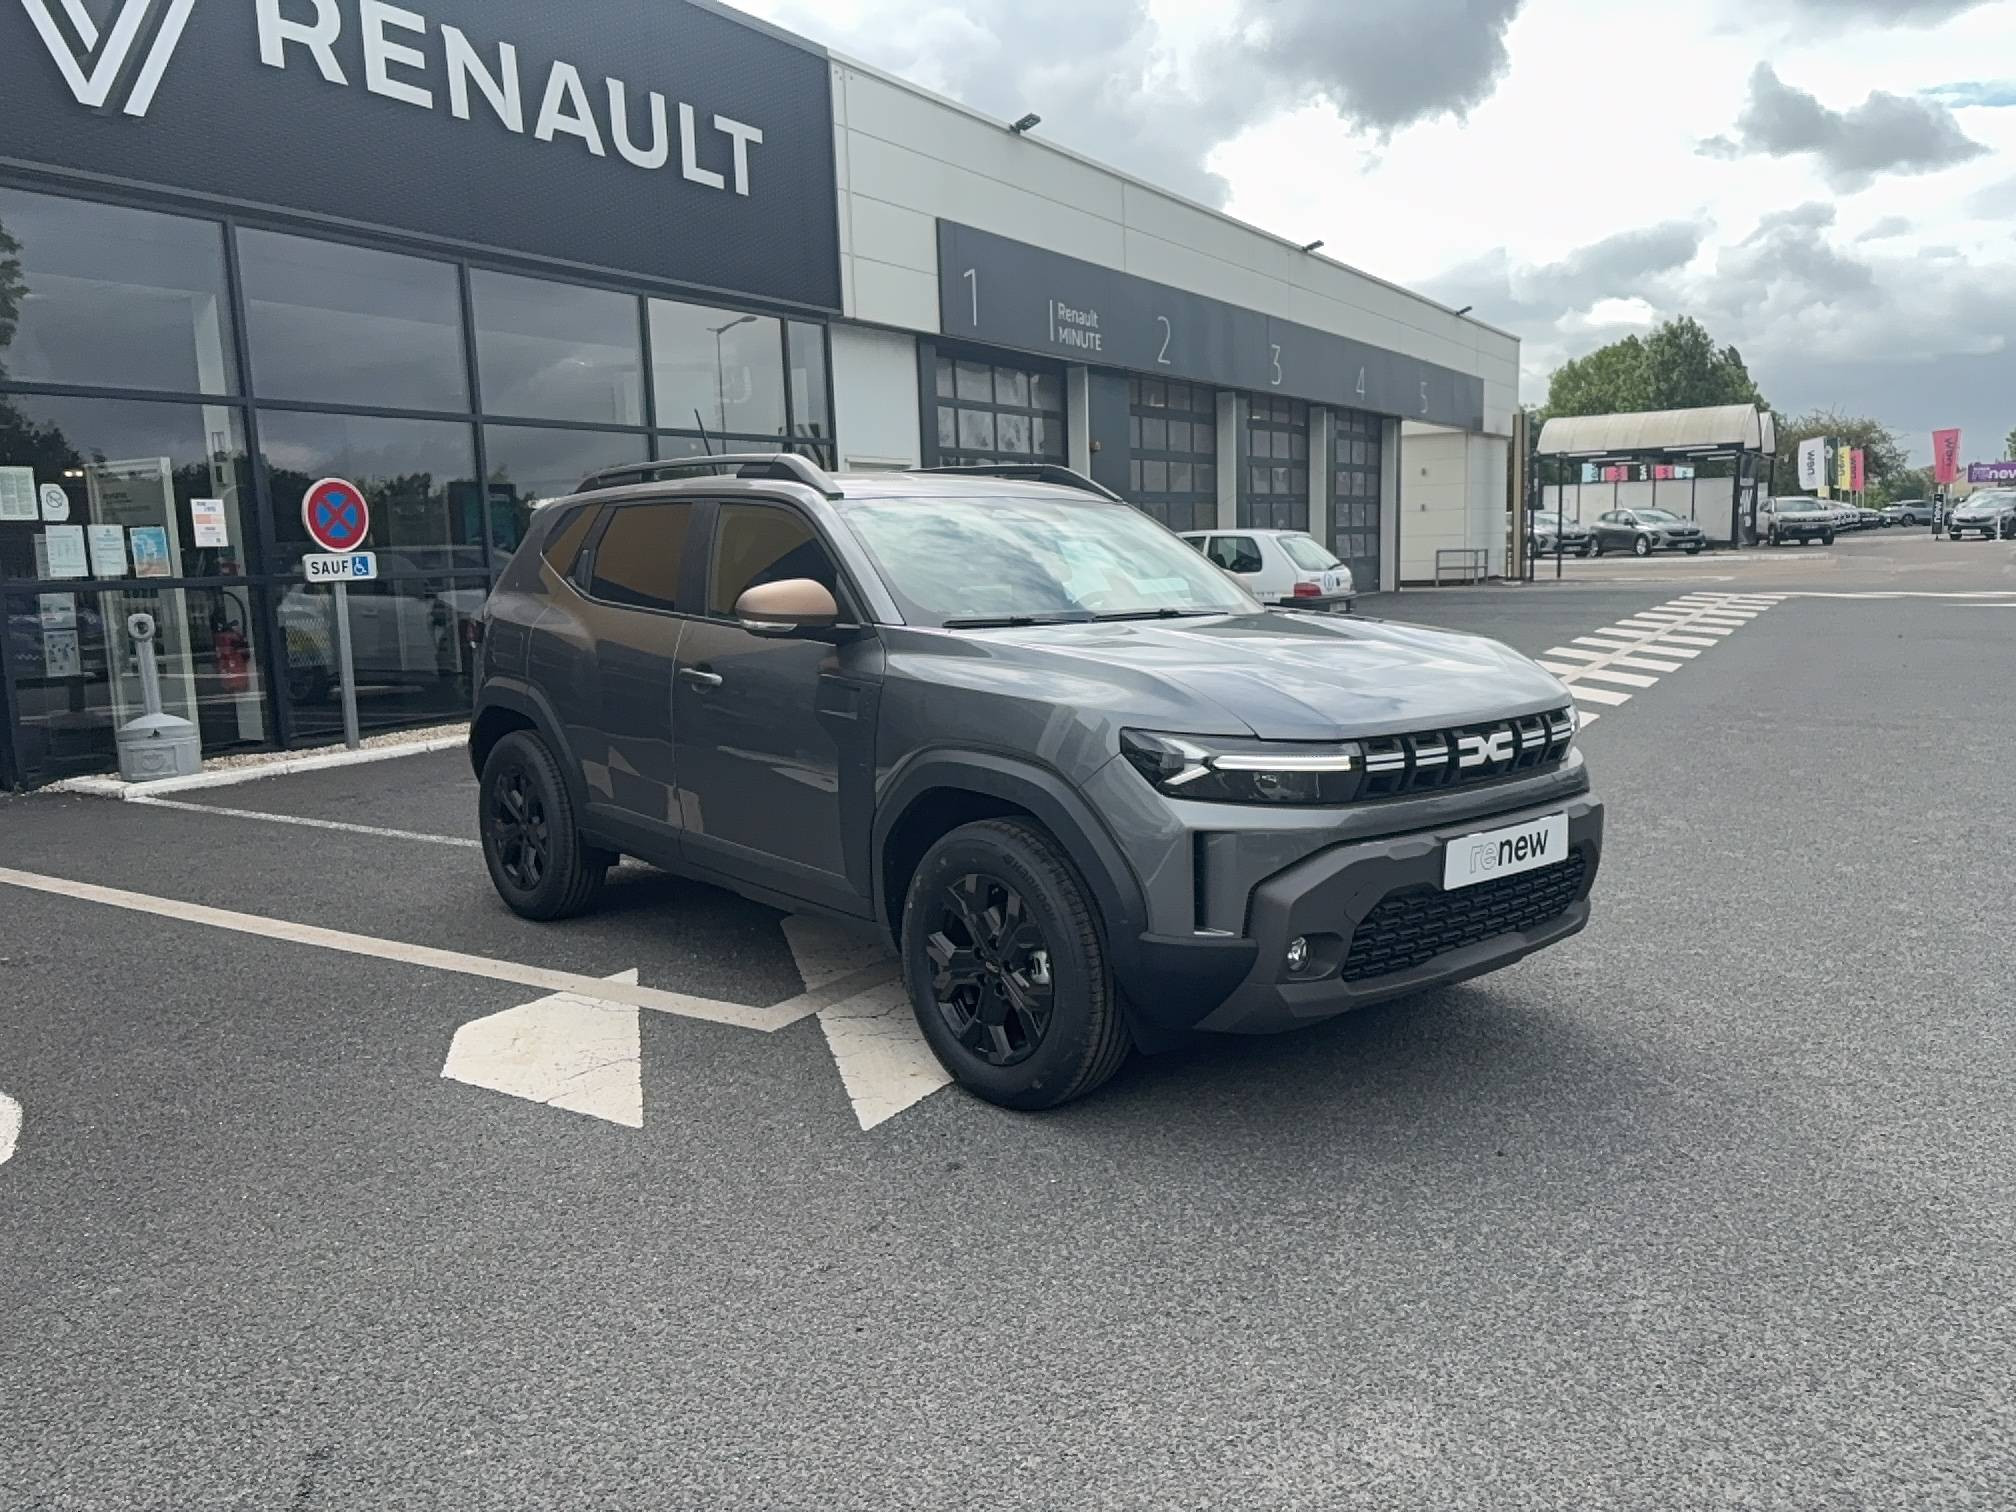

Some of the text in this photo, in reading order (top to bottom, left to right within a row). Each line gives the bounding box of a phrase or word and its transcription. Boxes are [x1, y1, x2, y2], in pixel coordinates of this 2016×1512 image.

[256, 0, 763, 196] RENAULT
[963, 268, 978, 327] 1
[1057, 302, 1099, 329] Renault
[1058, 327, 1102, 351] MINUTE
[1157, 315, 1171, 365] 2
[1271, 343, 1283, 386] 3
[1356, 366, 1365, 401] 4
[1420, 381, 1429, 415] 5
[311, 560, 348, 575] SAUF
[1469, 829, 1549, 874] renew
